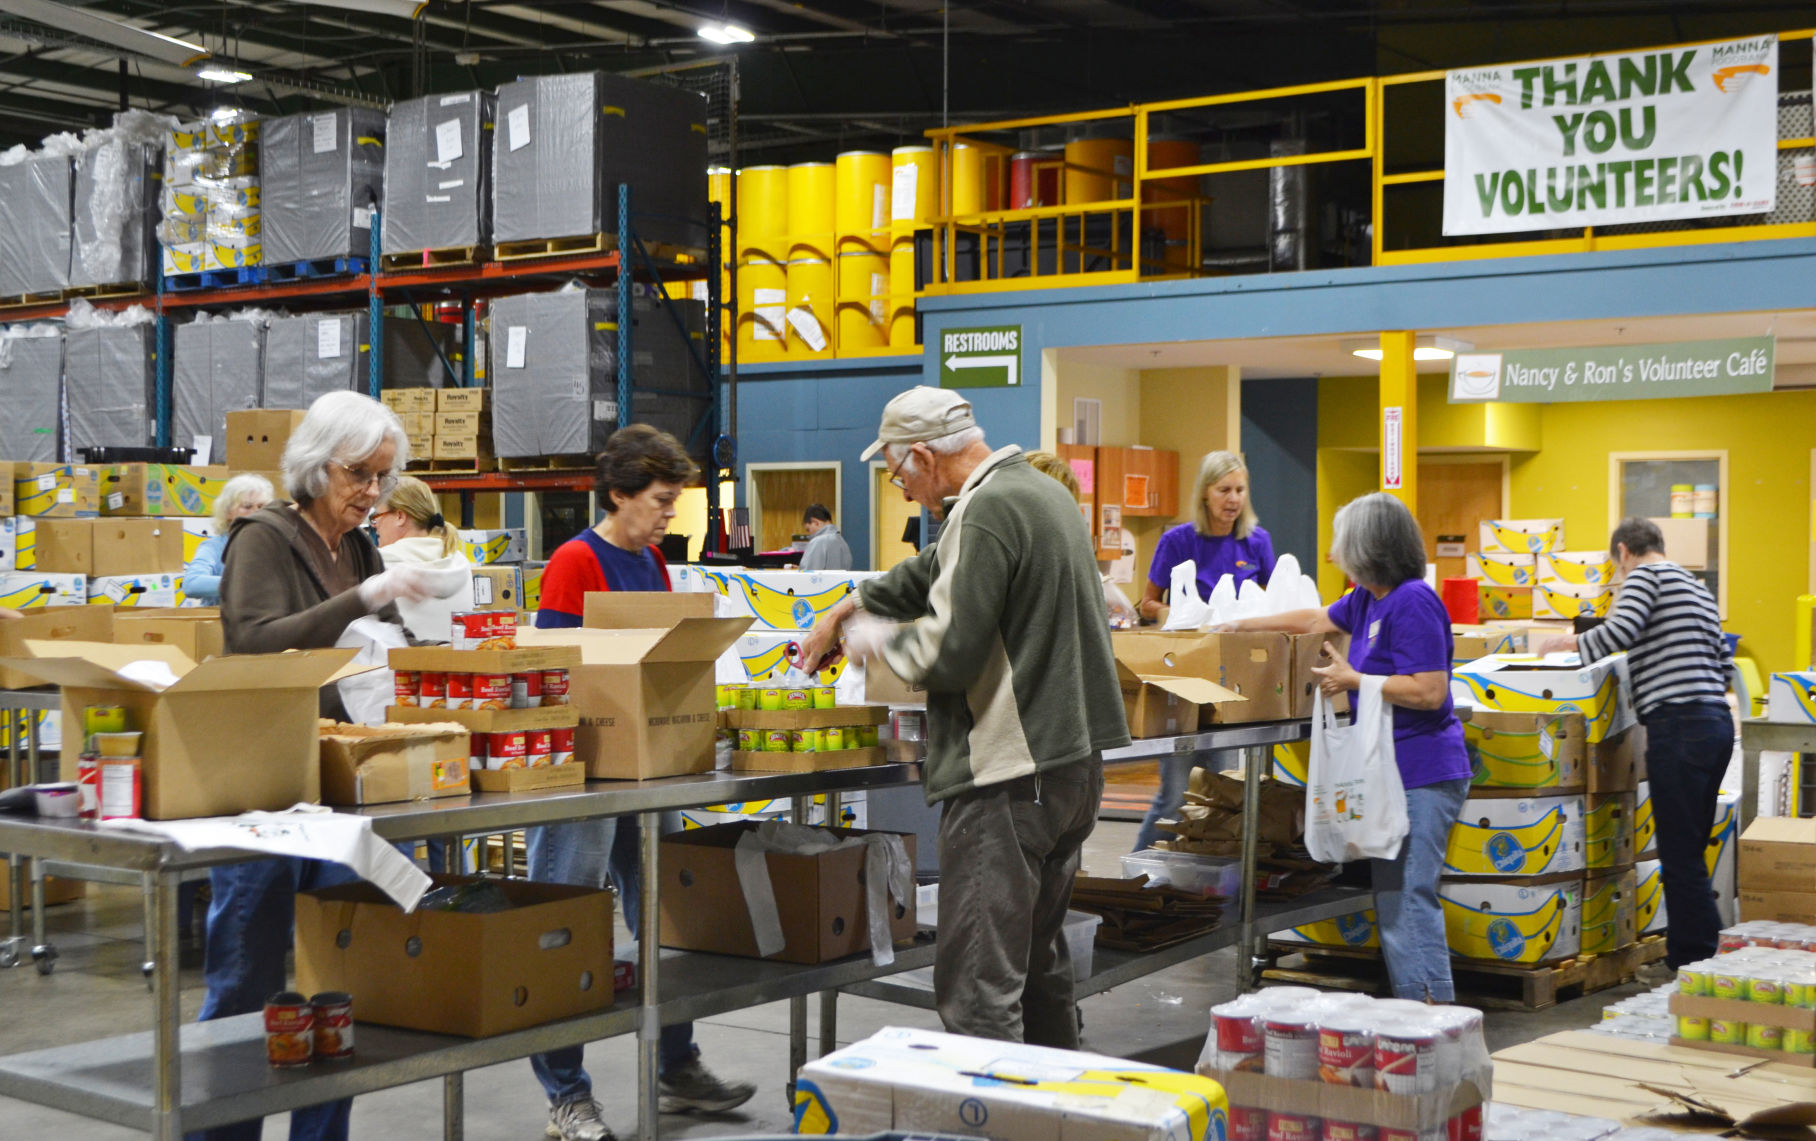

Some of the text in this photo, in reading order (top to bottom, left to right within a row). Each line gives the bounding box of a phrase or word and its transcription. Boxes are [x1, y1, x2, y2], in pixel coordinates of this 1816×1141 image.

[1712, 39, 1769, 57] MANNA
[1513, 50, 1698, 109] THANK
[1552, 105, 1657, 157] YOU
[1474, 149, 1744, 218] VOLUNTEERS!
[944, 330, 1018, 353] RESTROOMS
[1505, 348, 1767, 390] Nancy & Ron's Volunteer Café
